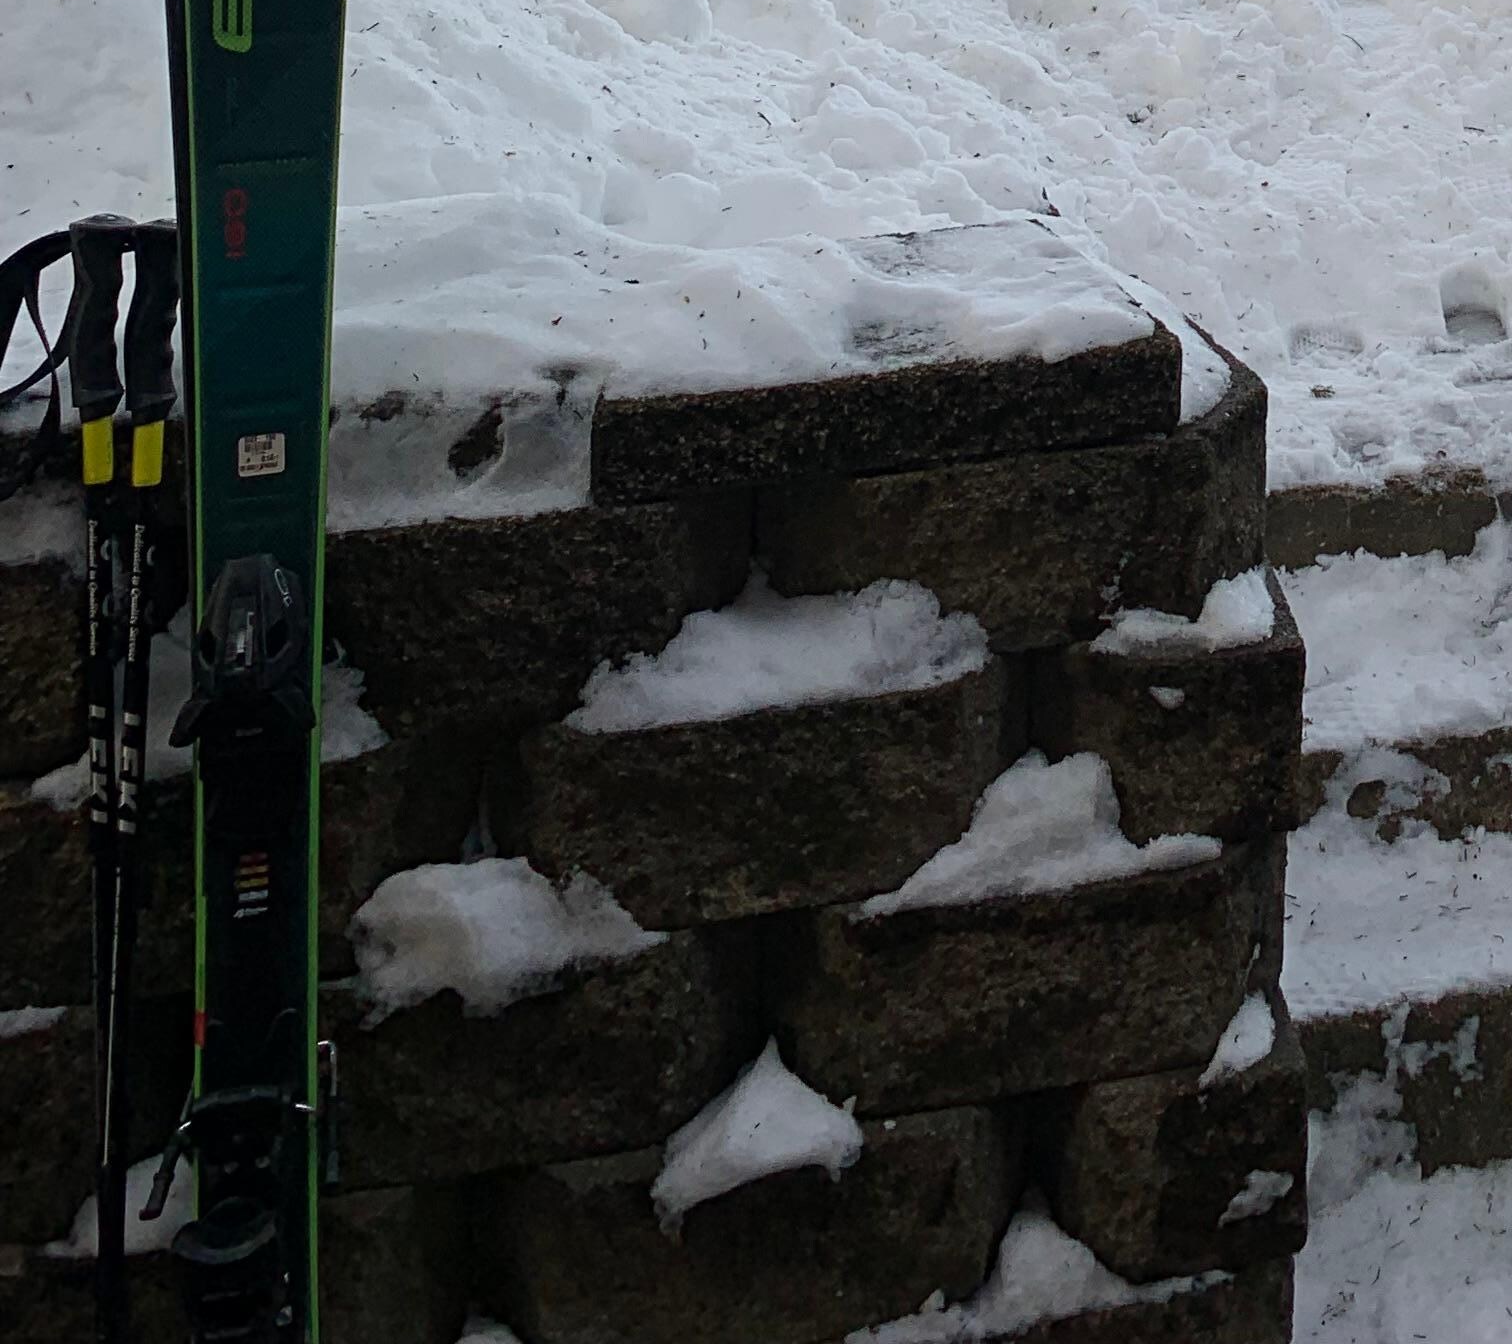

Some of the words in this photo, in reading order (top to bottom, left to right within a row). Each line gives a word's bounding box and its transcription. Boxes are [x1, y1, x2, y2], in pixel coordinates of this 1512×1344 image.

[132, 524, 145, 573] Dedicated
[129, 587, 142, 624] Quality
[127, 626, 140, 662] Service
